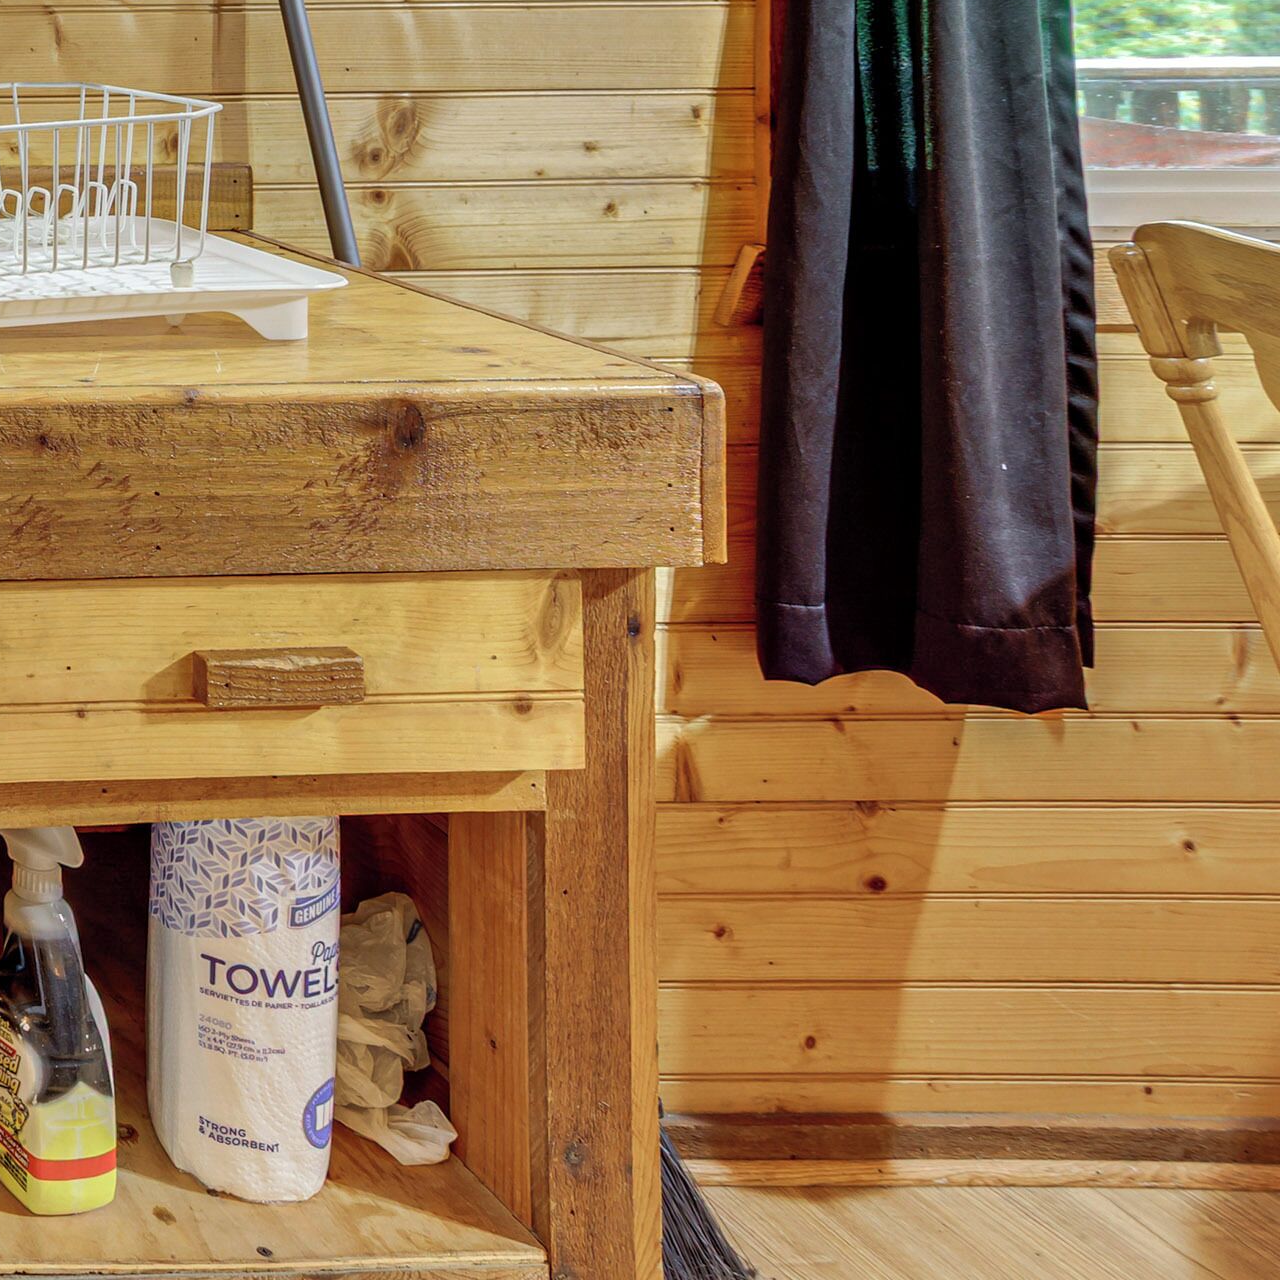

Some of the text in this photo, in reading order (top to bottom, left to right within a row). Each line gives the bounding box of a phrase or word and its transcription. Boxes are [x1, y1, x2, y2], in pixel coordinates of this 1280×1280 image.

[294, 889, 337, 924] GENUINE
[199, 987, 250, 1007] SERVIETTES
[251, 1000, 263, 1008] DE
[265, 1002, 293, 1010] PAPIER
[199, 1116, 247, 1138] STRONG
[208, 1131, 280, 1153] ABSORBENT
